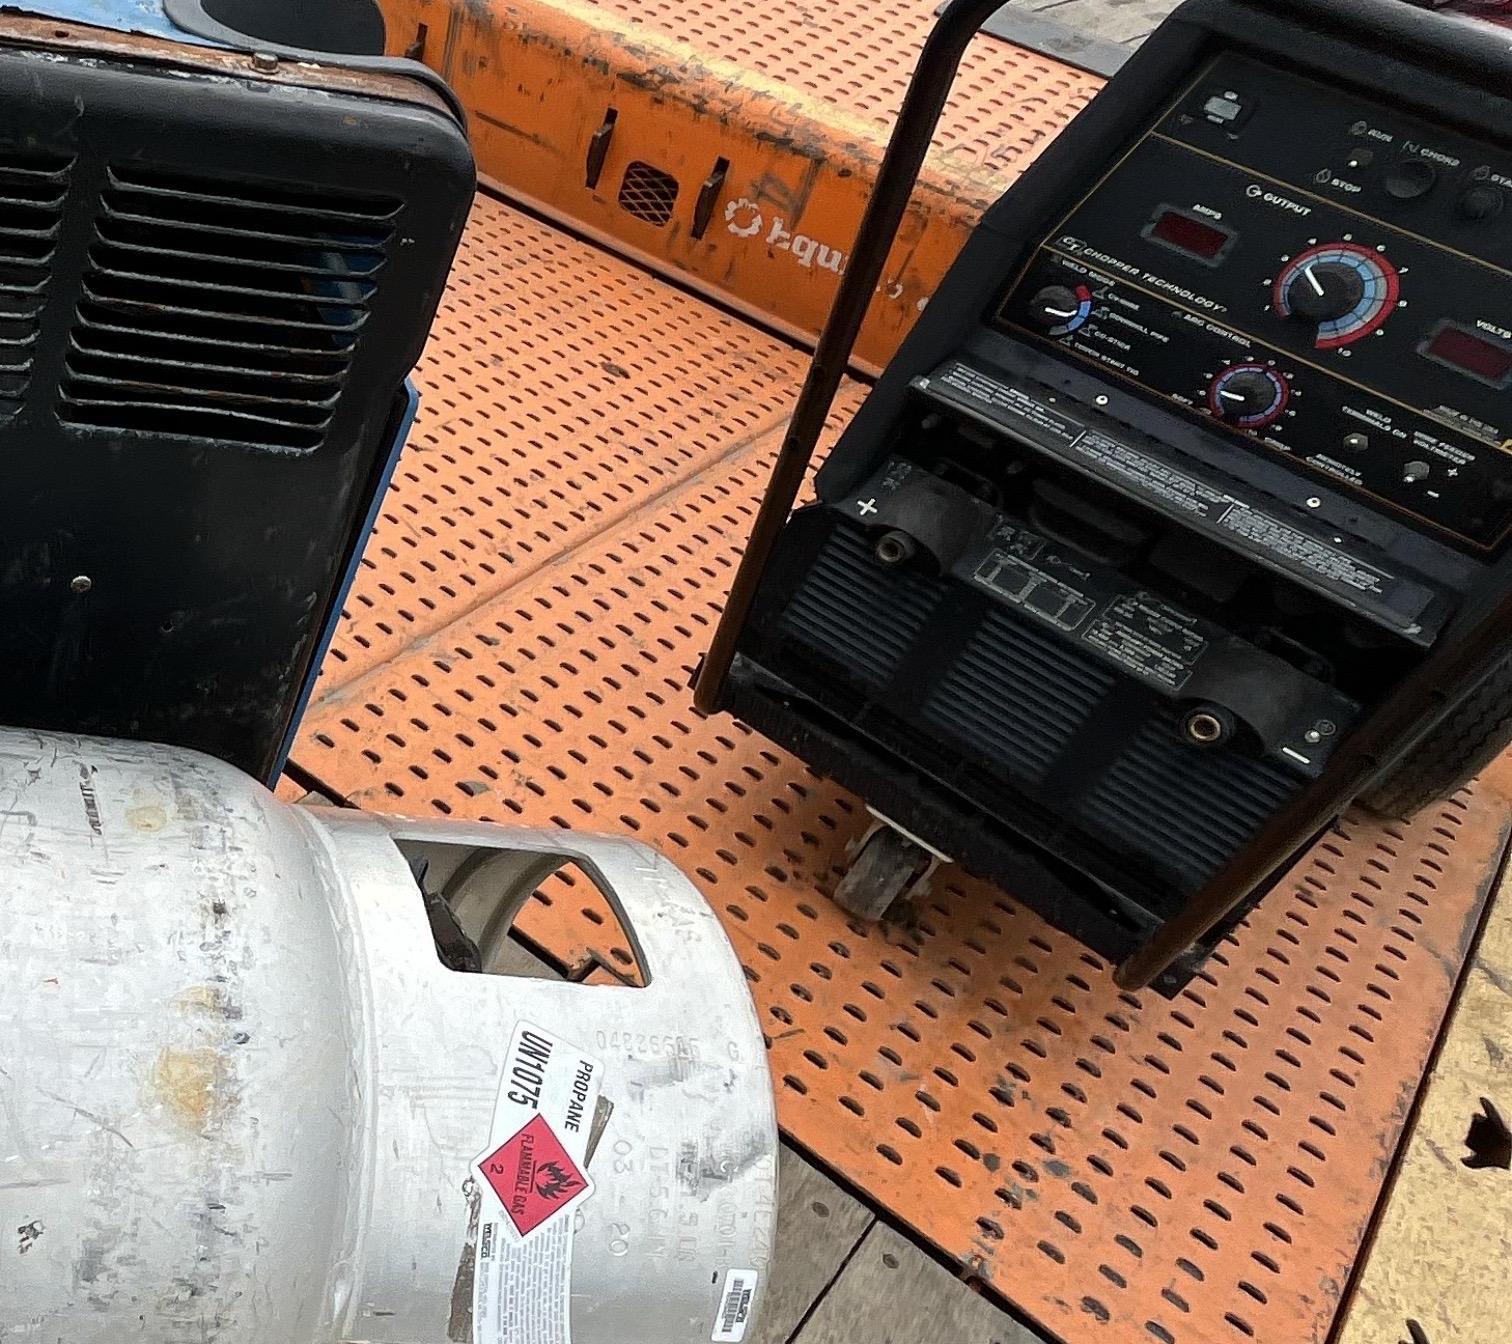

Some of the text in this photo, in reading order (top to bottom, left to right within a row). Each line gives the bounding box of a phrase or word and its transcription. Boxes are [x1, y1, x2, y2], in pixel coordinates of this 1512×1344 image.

[1330, 177, 1362, 193] STOP
[1263, 192, 1312, 216] OUTPUT
[1083, 248, 1140, 275] CHOPPER
[507, 1030, 554, 1110] UN1075
[564, 1059, 594, 1134] PROPANE
[490, 1163, 504, 1175] 2
[511, 1133, 535, 1216] FLAMMABLE GAS
